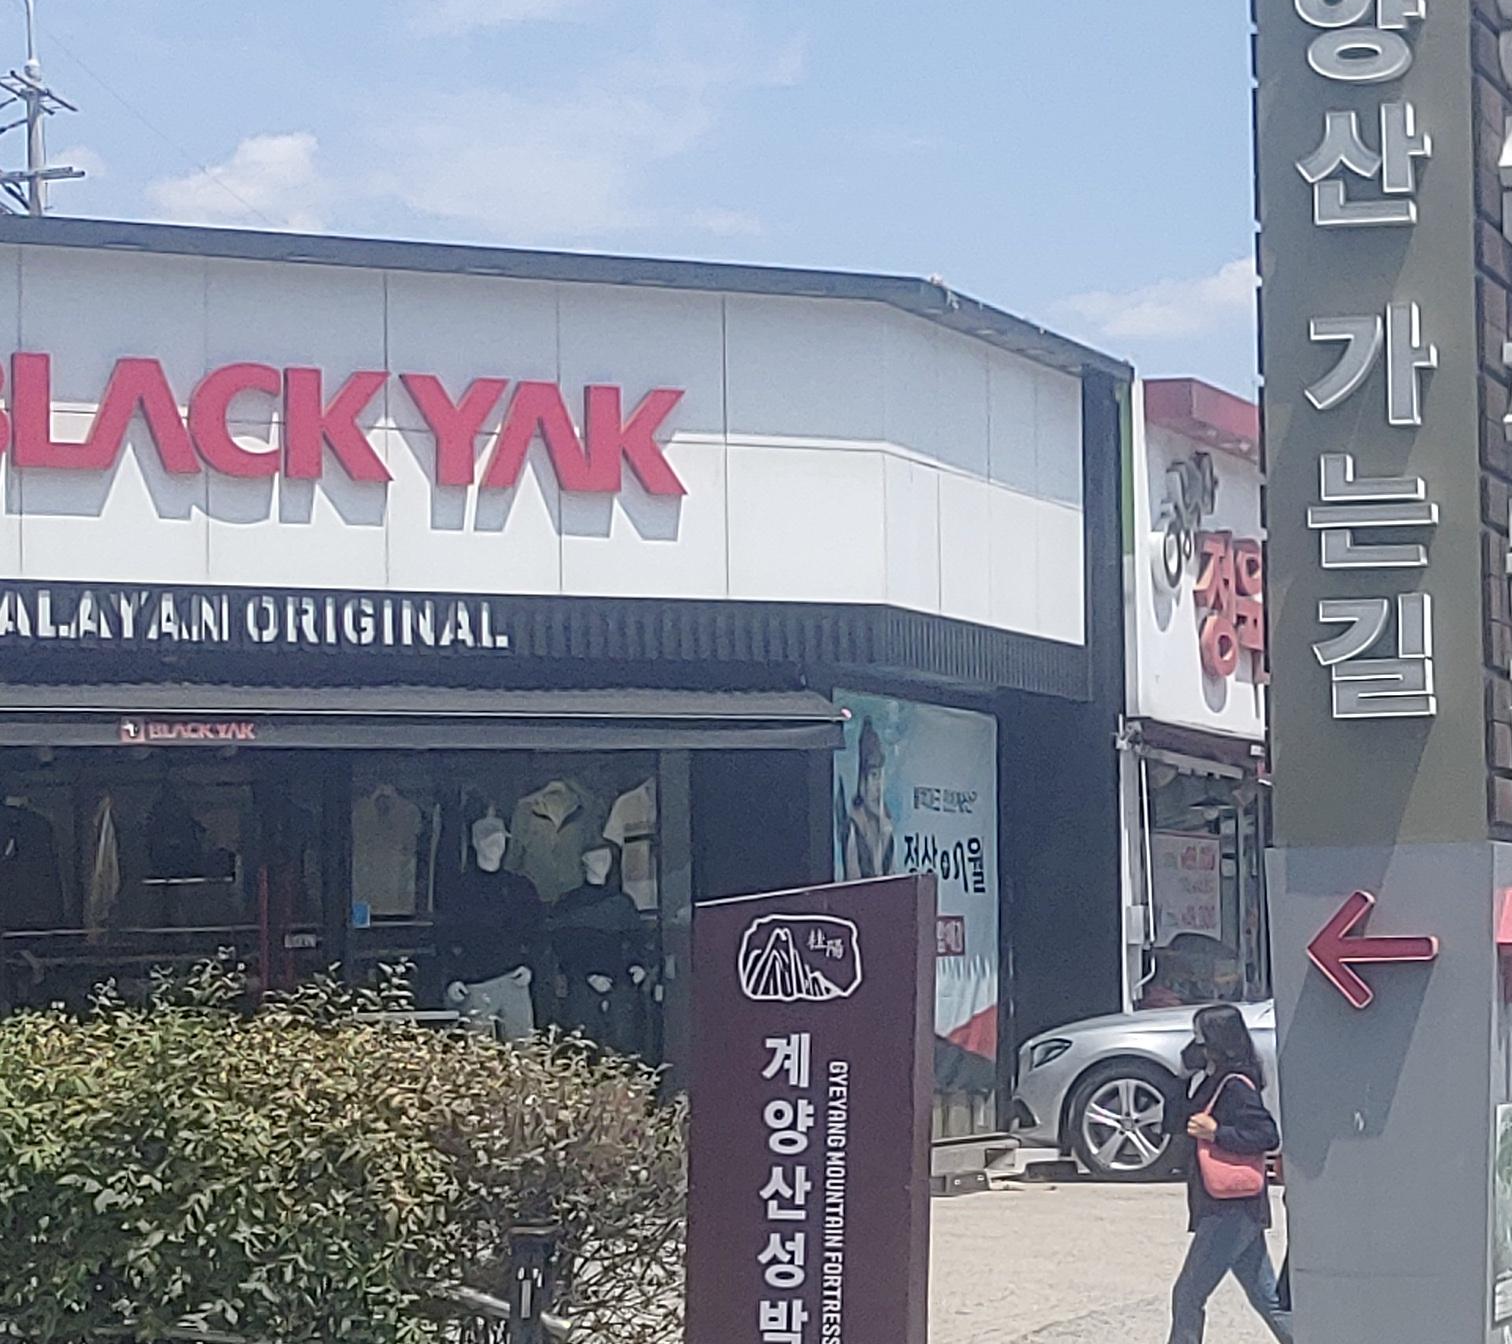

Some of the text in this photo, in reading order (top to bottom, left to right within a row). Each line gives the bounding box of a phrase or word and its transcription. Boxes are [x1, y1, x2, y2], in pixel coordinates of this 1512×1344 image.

[1303, 300, 1439, 719] 가는길
[246, 595, 509, 649] ORIGINAL
[826, 1060, 848, 1148] GYEYANG
[824, 1152, 846, 1248] MOUNTAIN
